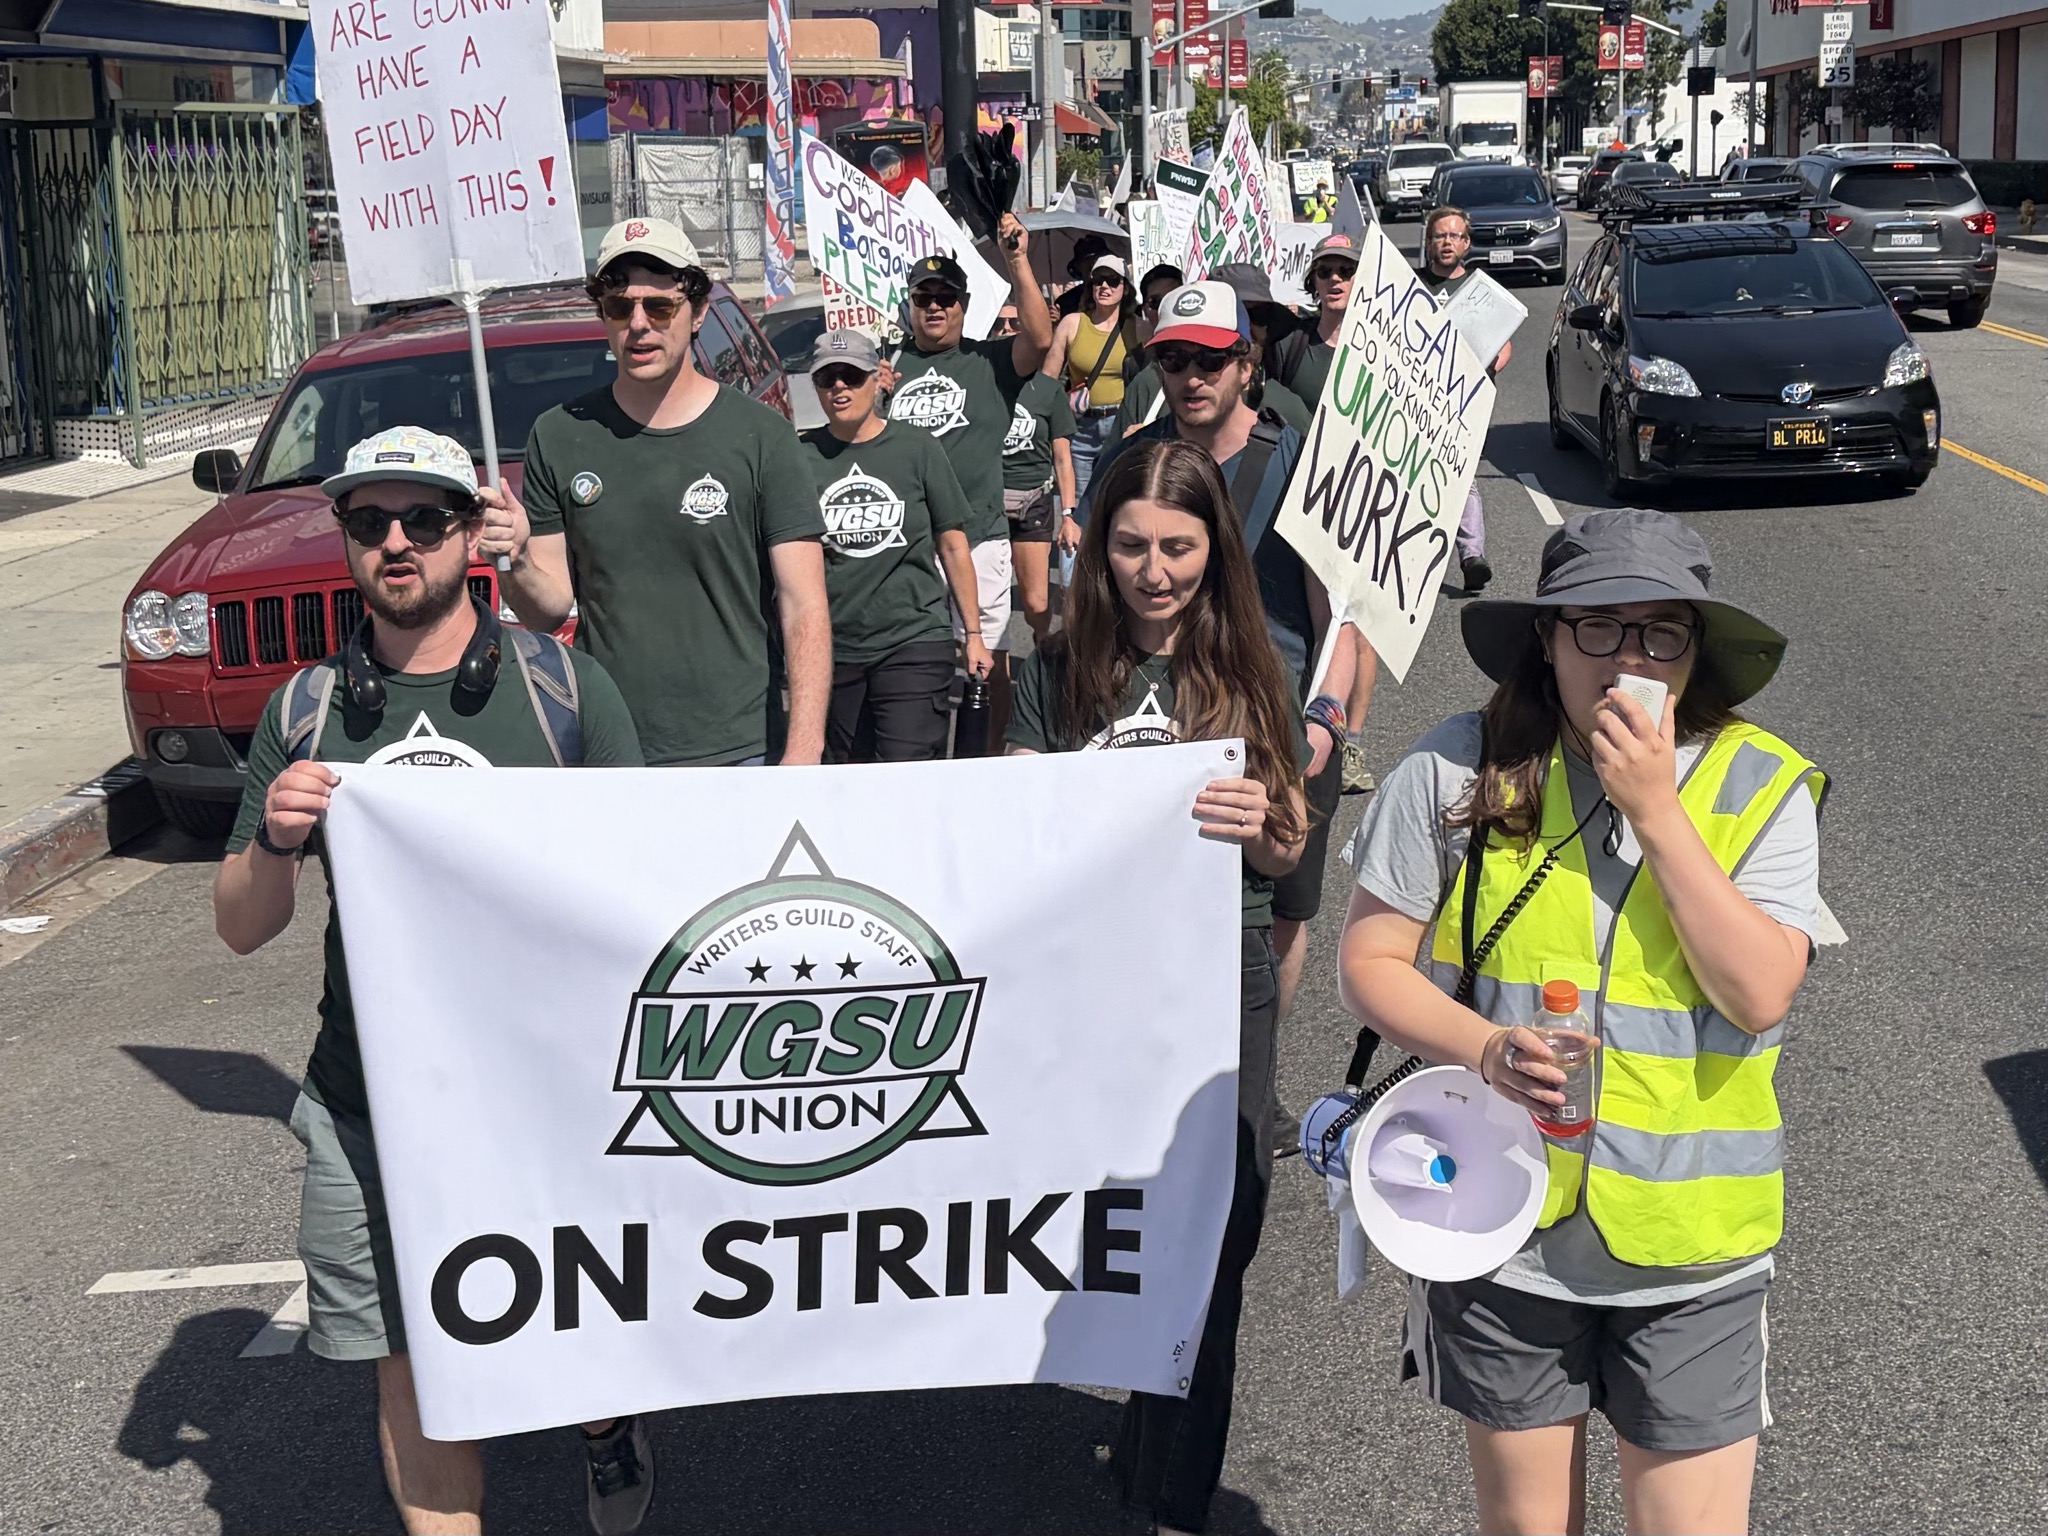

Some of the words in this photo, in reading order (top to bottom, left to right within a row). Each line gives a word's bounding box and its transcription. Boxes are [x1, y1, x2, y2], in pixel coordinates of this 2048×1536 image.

[331, 0, 392, 51] ARE
[1009, 31, 1032, 44] PIZZ
[357, 45, 429, 100] HAVE
[460, 36, 481, 75] A
[1823, 46, 1852, 55] SPEED
[1825, 56, 1848, 64] LIMIT
[1824, 67, 1851, 82] 35
[355, 113, 434, 164] FIELD
[450, 96, 507, 146] DAY
[360, 184, 438, 231] WITH
[827, 305, 876, 331] GREED
[1375, 234, 1486, 417] WGAW
[892, 392, 963, 418] WGSU
[1351, 321, 1378, 365] DO
[1383, 353, 1406, 399] YOU
[1401, 391, 1442, 445] KNOW
[1437, 430, 1468, 479] HOW
[1333, 343, 1448, 519] UNIONS
[1773, 430, 1789, 446] BL
[1795, 429, 1826, 445] PR14
[684, 492, 728, 506] WGSU
[1302, 403, 1449, 625] WORK?
[836, 530, 883, 545] UNION
[413, 753, 451, 766] GUILD
[1139, 730, 1171, 743] GUILD
[687, 914, 779, 977] WRITERS
[785, 908, 855, 930] GUILD
[860, 920, 918, 970] STAFF
[636, 989, 974, 1081] WGSU
[714, 1089, 887, 1136] UNION
[430, 1222, 648, 1346] ON
[692, 1188, 1143, 1321] STRIKE
